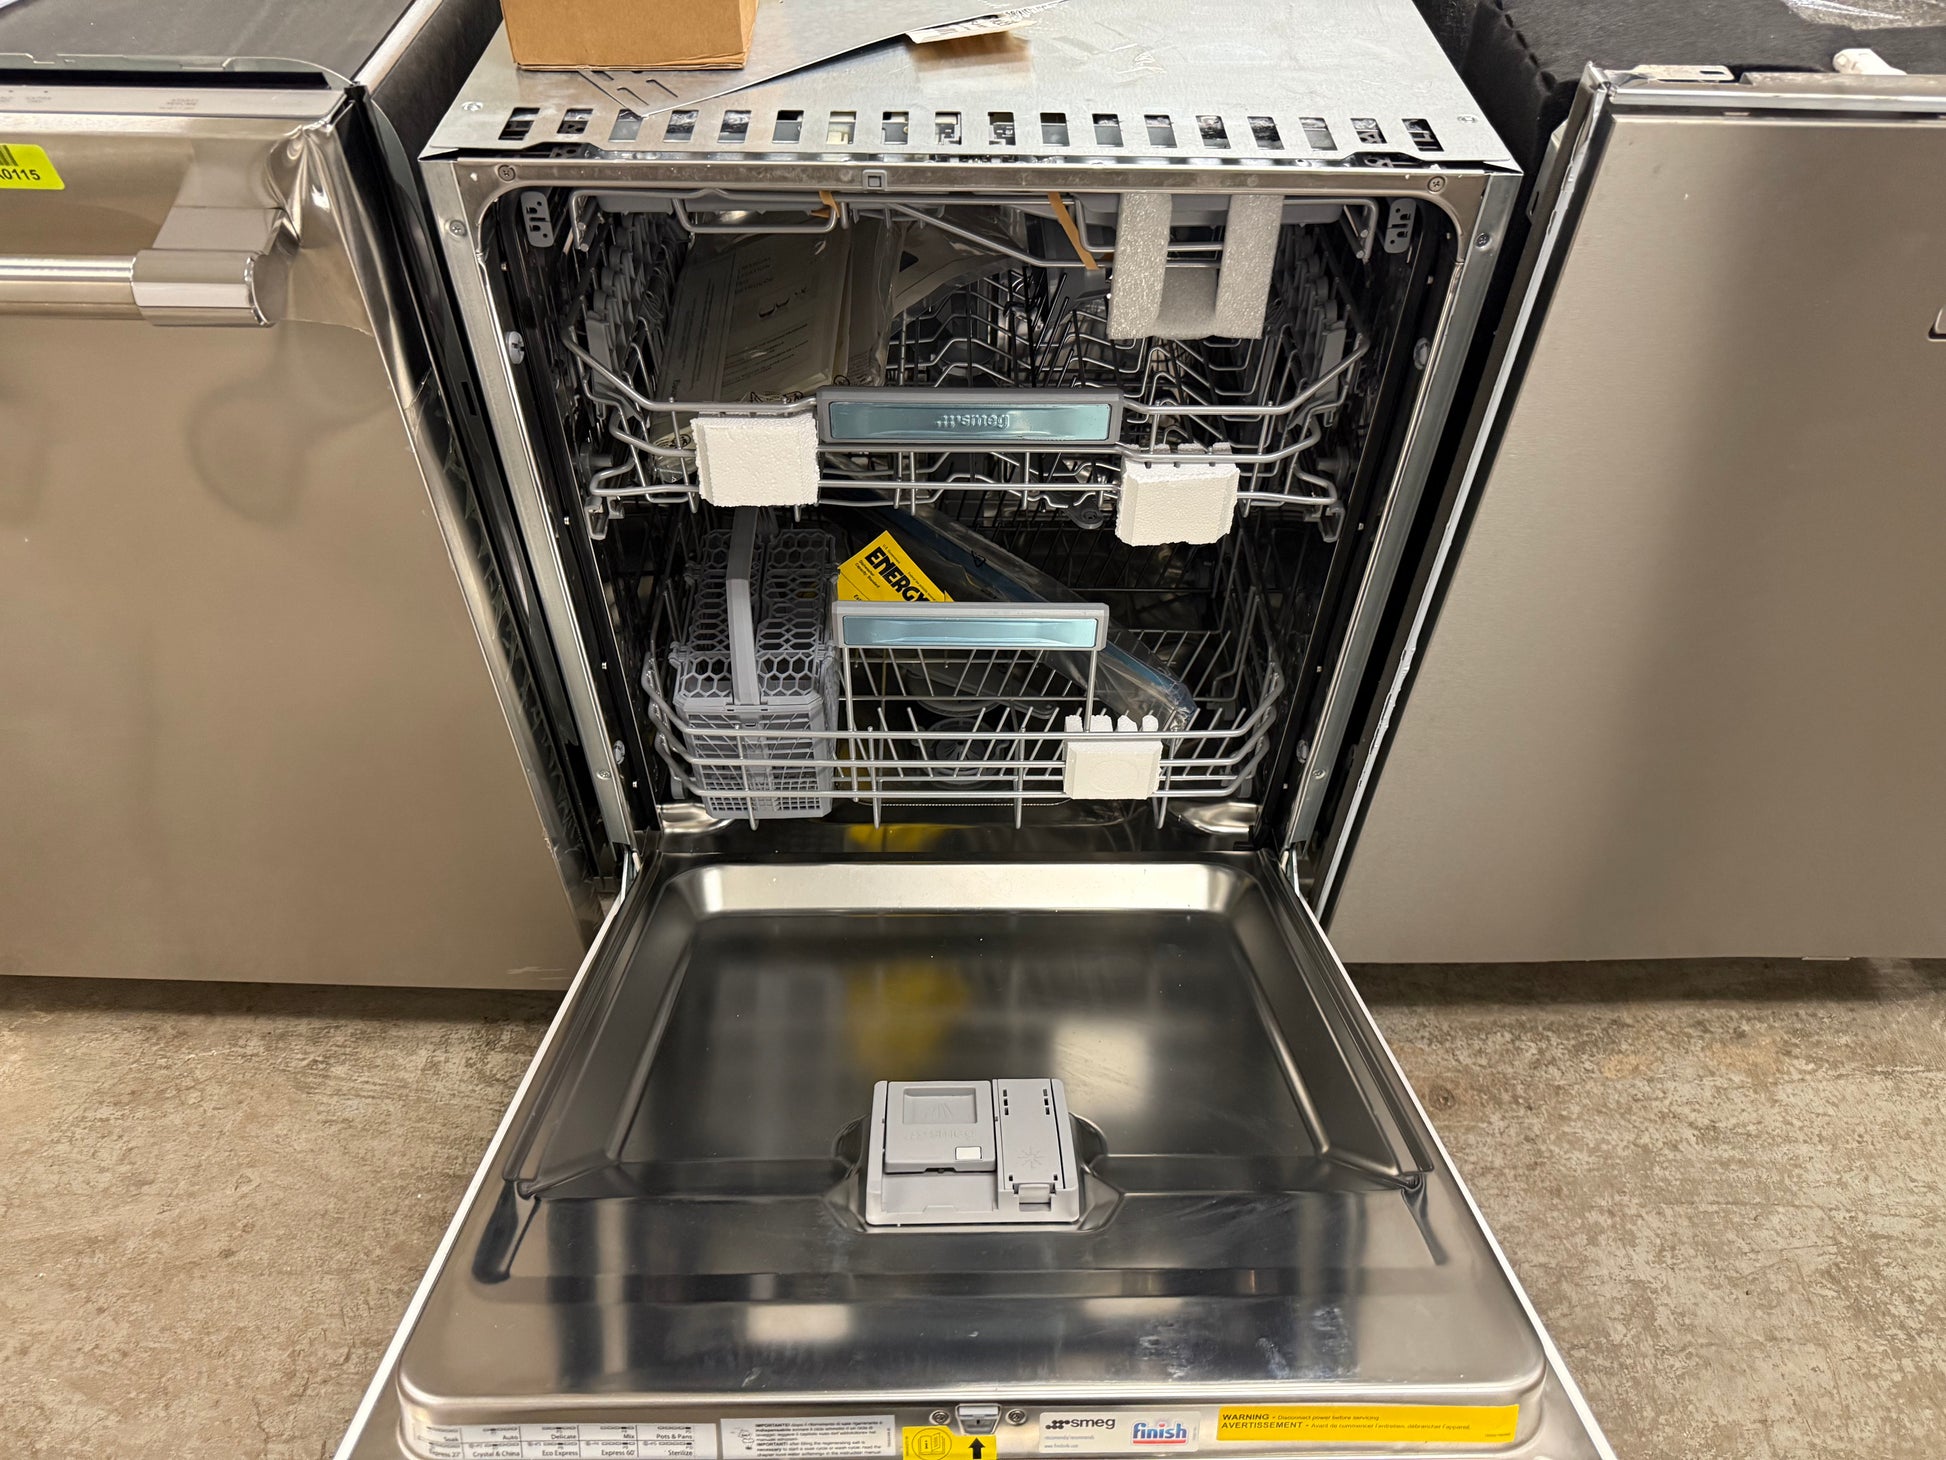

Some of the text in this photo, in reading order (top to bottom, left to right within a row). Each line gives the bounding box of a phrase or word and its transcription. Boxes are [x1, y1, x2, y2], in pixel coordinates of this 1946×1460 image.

[962, 414, 1009, 430] smeg
[1223, 1413, 1269, 1421] WARNING
[1070, 1418, 1116, 1430] smeg
[1222, 1421, 1304, 1429] AVERTISSEMENT
[1133, 1422, 1187, 1439] finish
